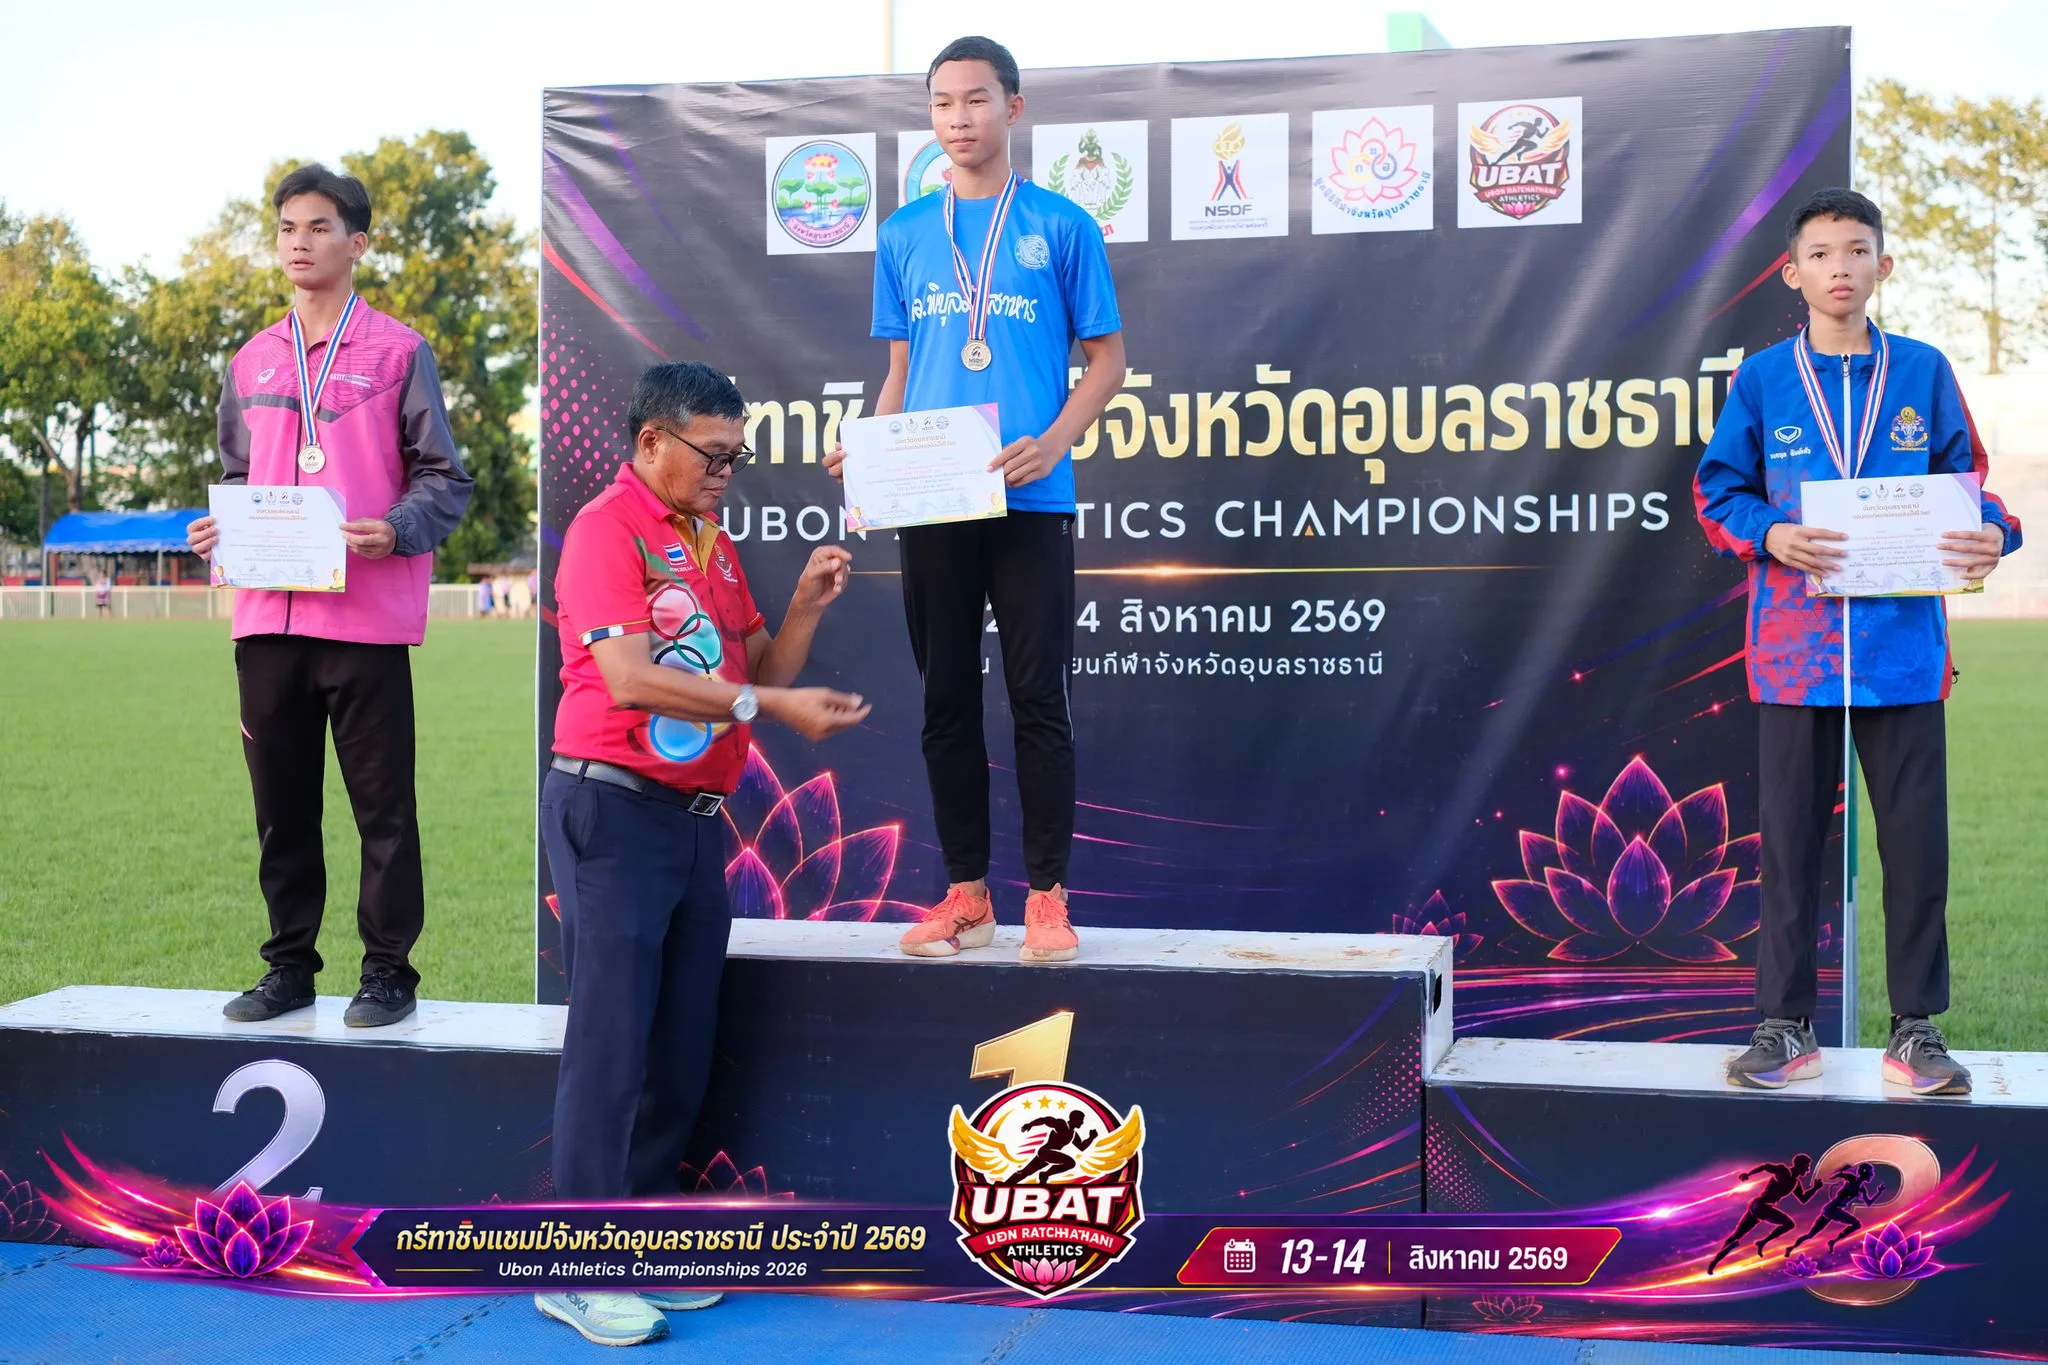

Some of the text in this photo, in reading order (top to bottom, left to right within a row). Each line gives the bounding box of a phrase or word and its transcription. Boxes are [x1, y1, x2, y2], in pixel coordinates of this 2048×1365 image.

[1477, 163, 1562, 187] UBAT
[1205, 204, 1252, 217] NSDF
[1215, 492, 1669, 537] CHAMPIONSHIPS
[1121, 598, 1271, 633] สิงหาคม
[1290, 598, 1386, 633] 2569
